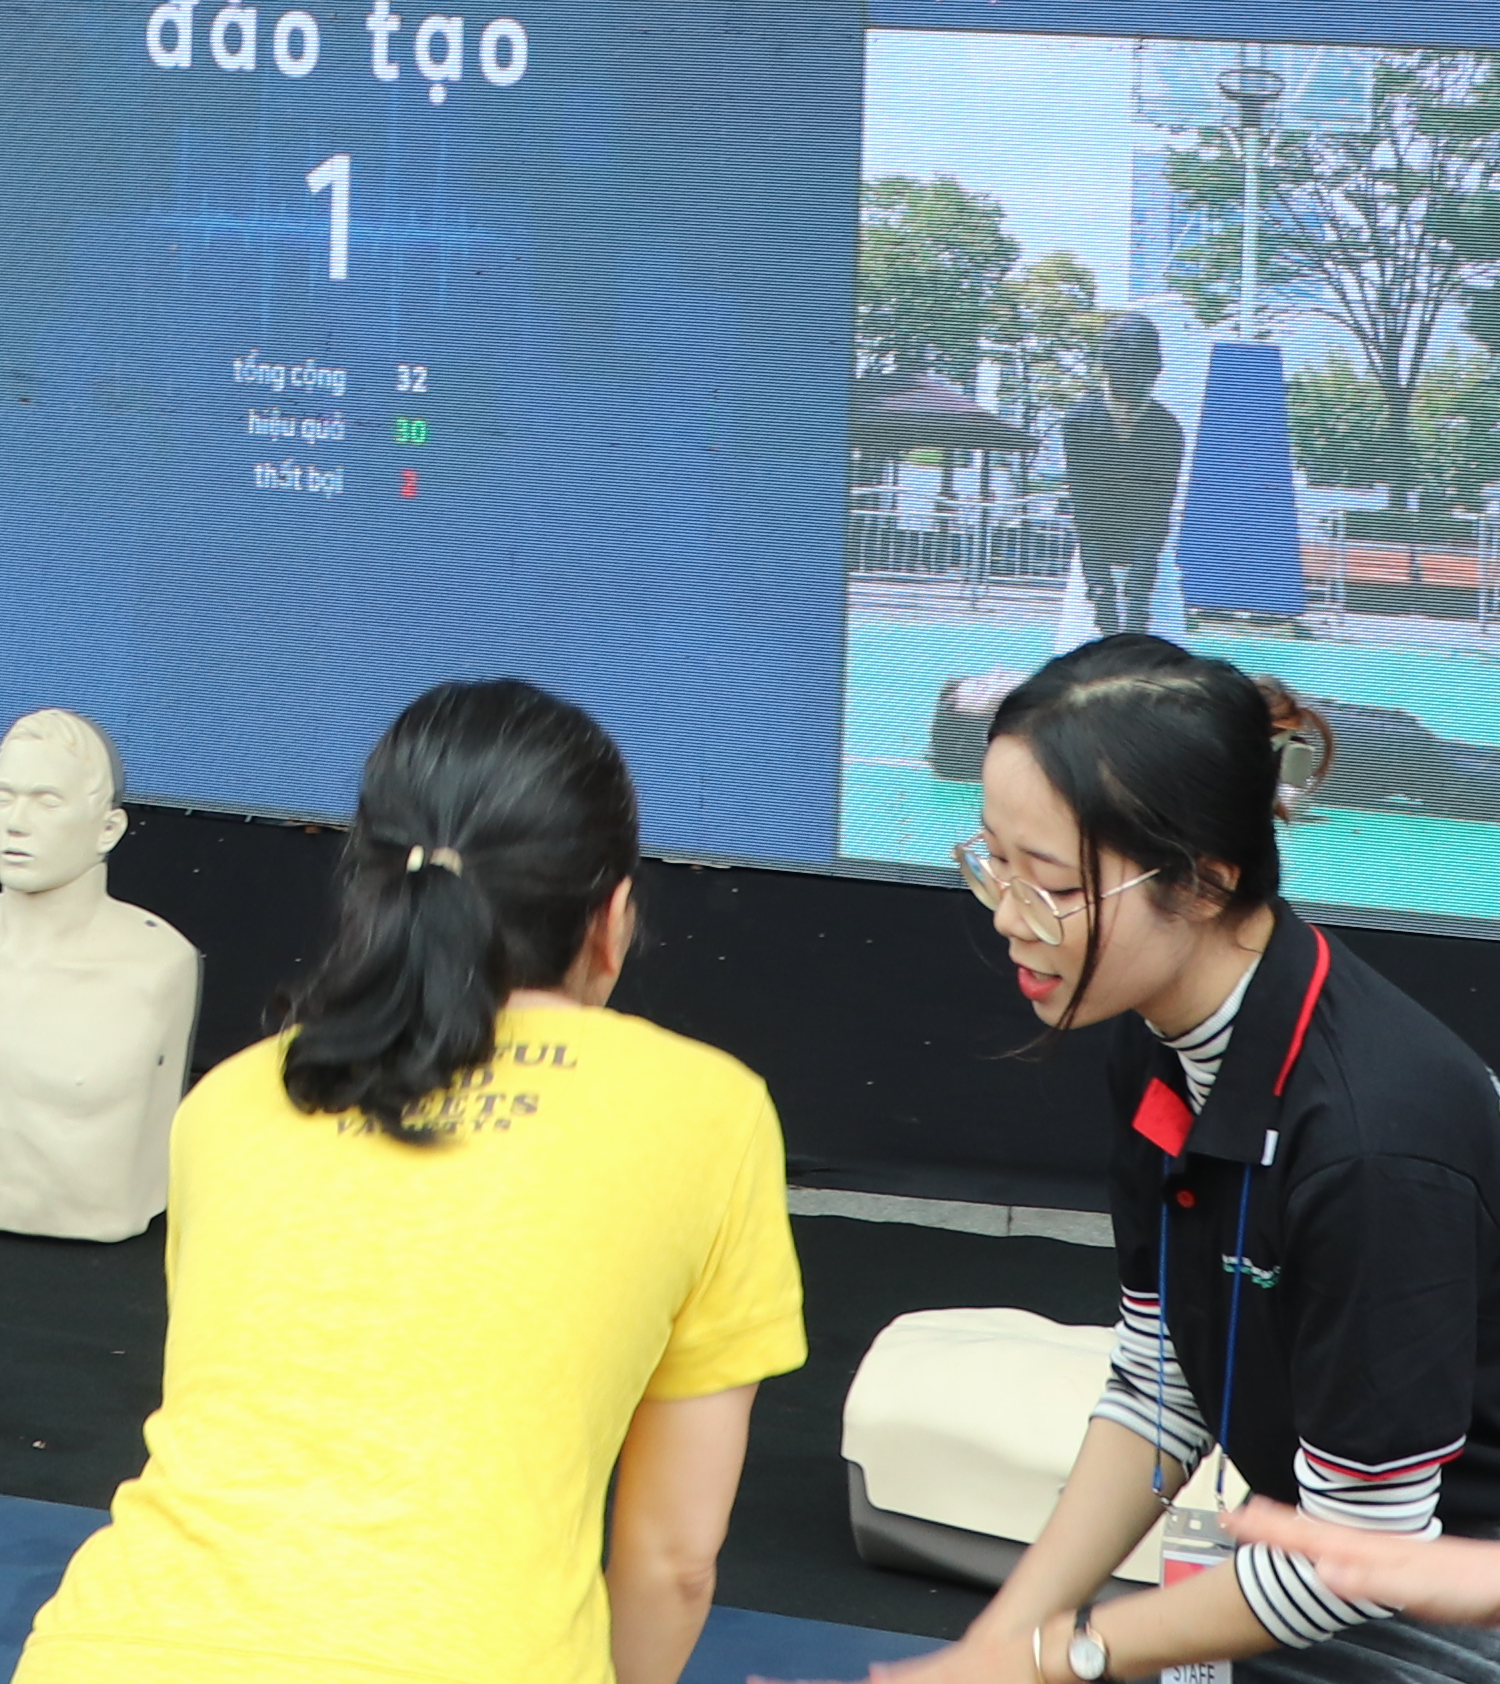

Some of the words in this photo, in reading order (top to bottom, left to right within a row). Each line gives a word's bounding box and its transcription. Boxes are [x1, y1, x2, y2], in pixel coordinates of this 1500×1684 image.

[304, 154, 352, 281] 1
[396, 363, 429, 393] 32
[394, 416, 428, 445] 30
[399, 469, 418, 499] 2
